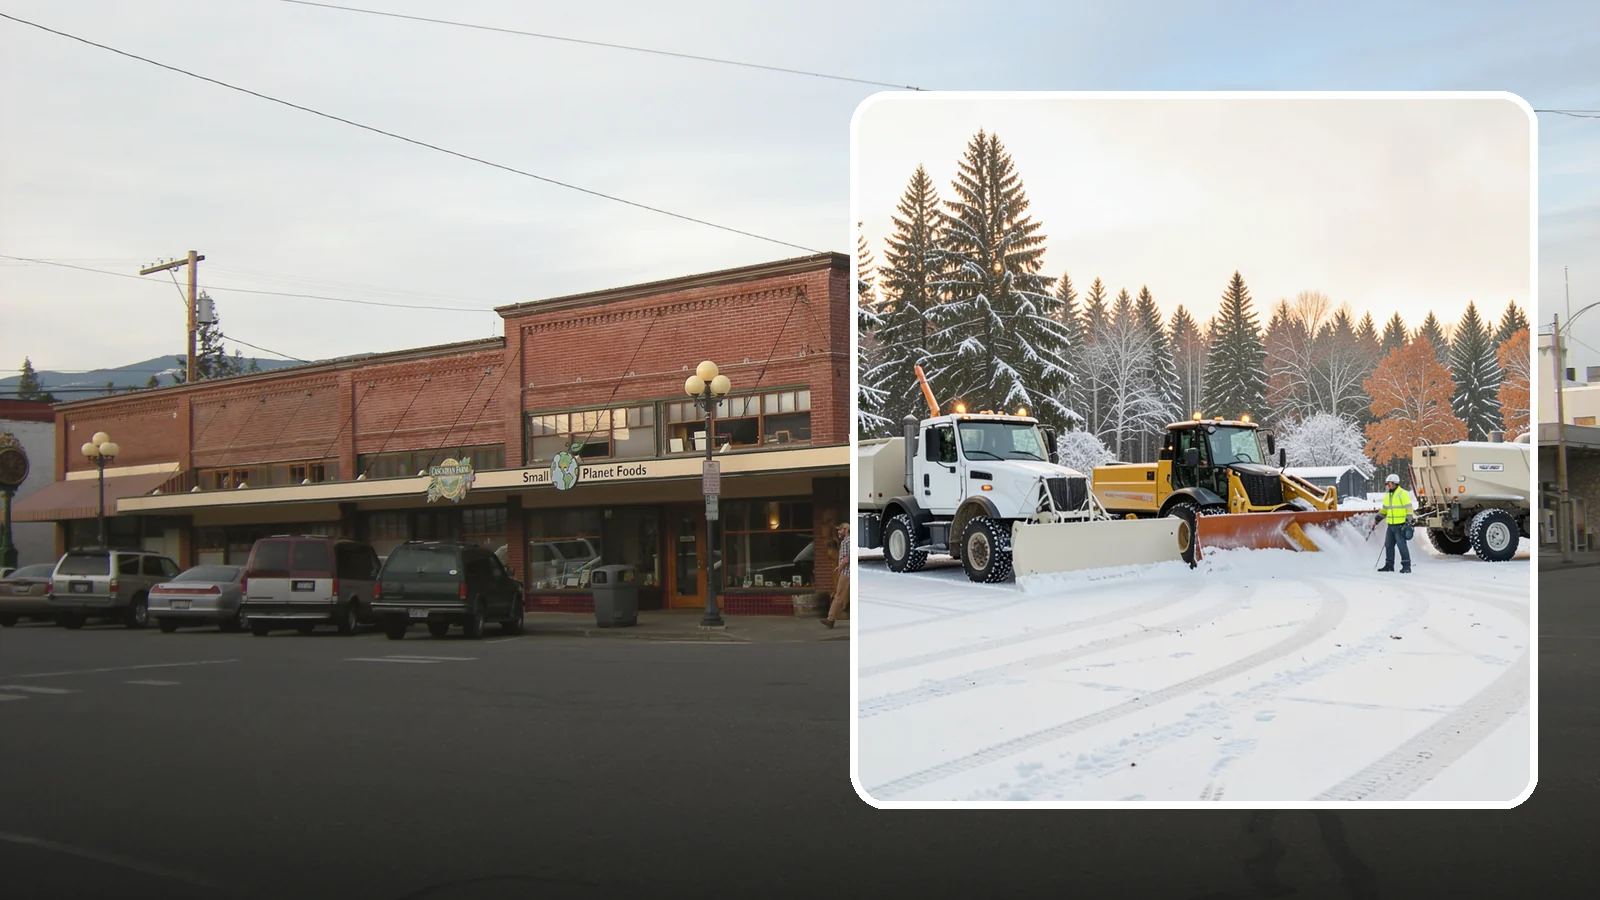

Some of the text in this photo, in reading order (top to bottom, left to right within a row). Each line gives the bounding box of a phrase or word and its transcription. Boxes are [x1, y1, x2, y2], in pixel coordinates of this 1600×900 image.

[523, 464, 647, 483] Small Planet Foods
